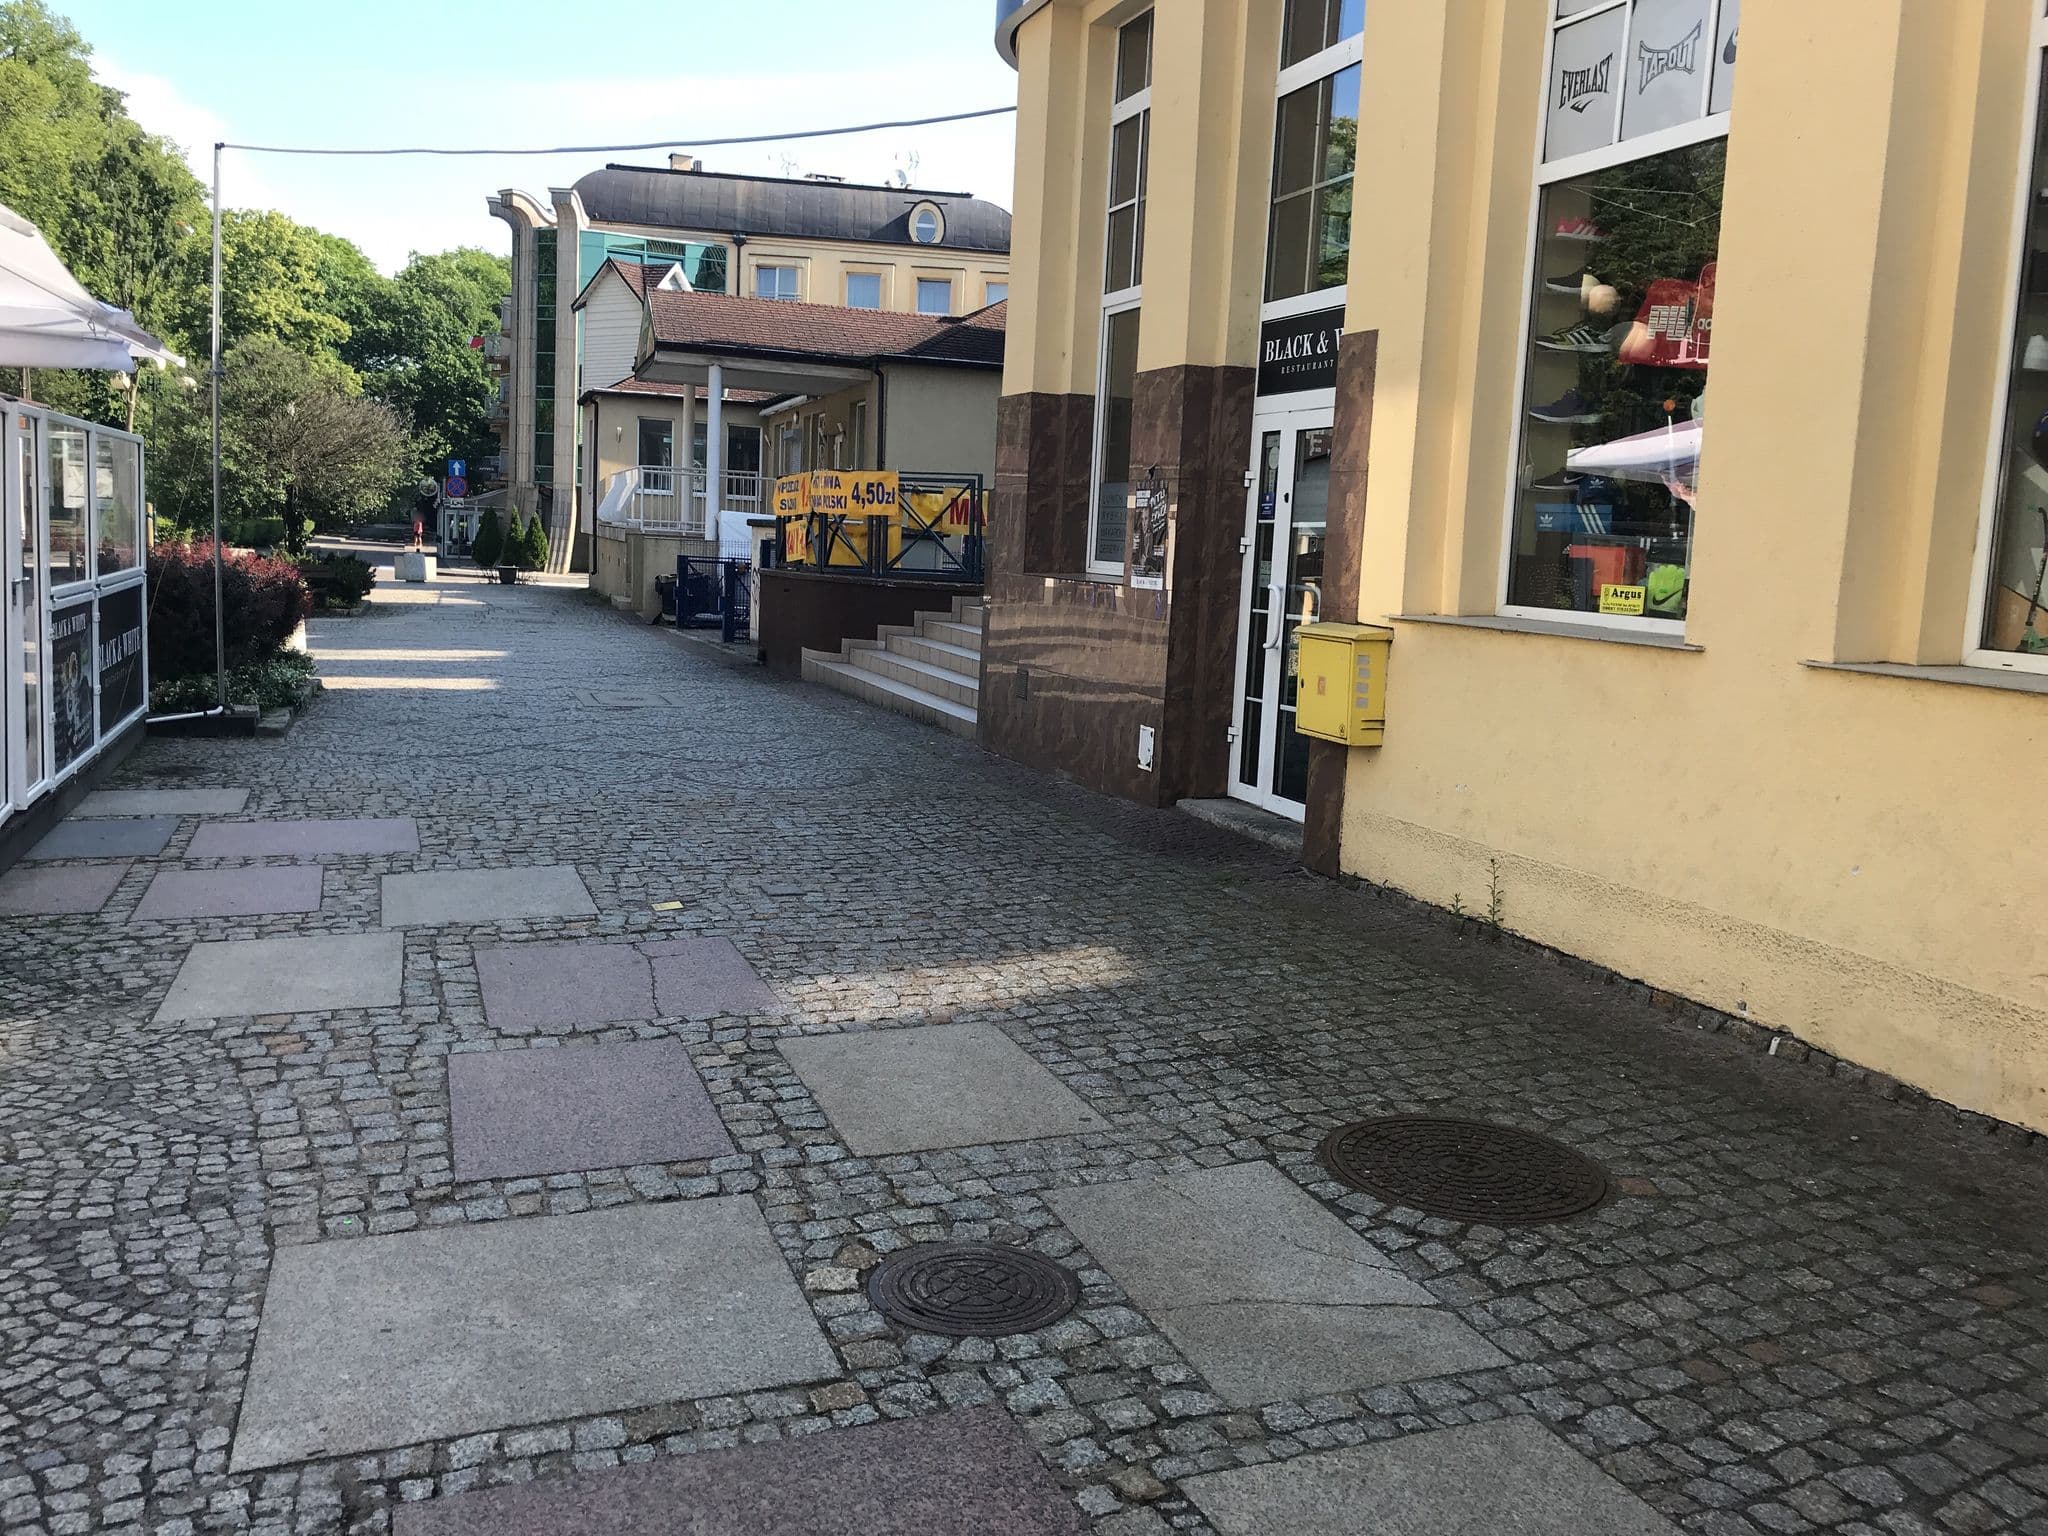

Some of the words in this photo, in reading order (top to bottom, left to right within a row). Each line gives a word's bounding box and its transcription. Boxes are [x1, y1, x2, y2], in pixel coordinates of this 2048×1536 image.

[1638, 19, 1702, 95] TAPOUT
[1559, 52, 1613, 109] EVERLAST
[1264, 333, 1314, 362] BLACK
[1316, 330, 1329, 354] &
[1281, 359, 1334, 374] RESTAURANT
[852, 482, 895, 509] 4,50zł
[1611, 588, 1642, 601] Argus
[122, 626, 141, 656] WHITE
